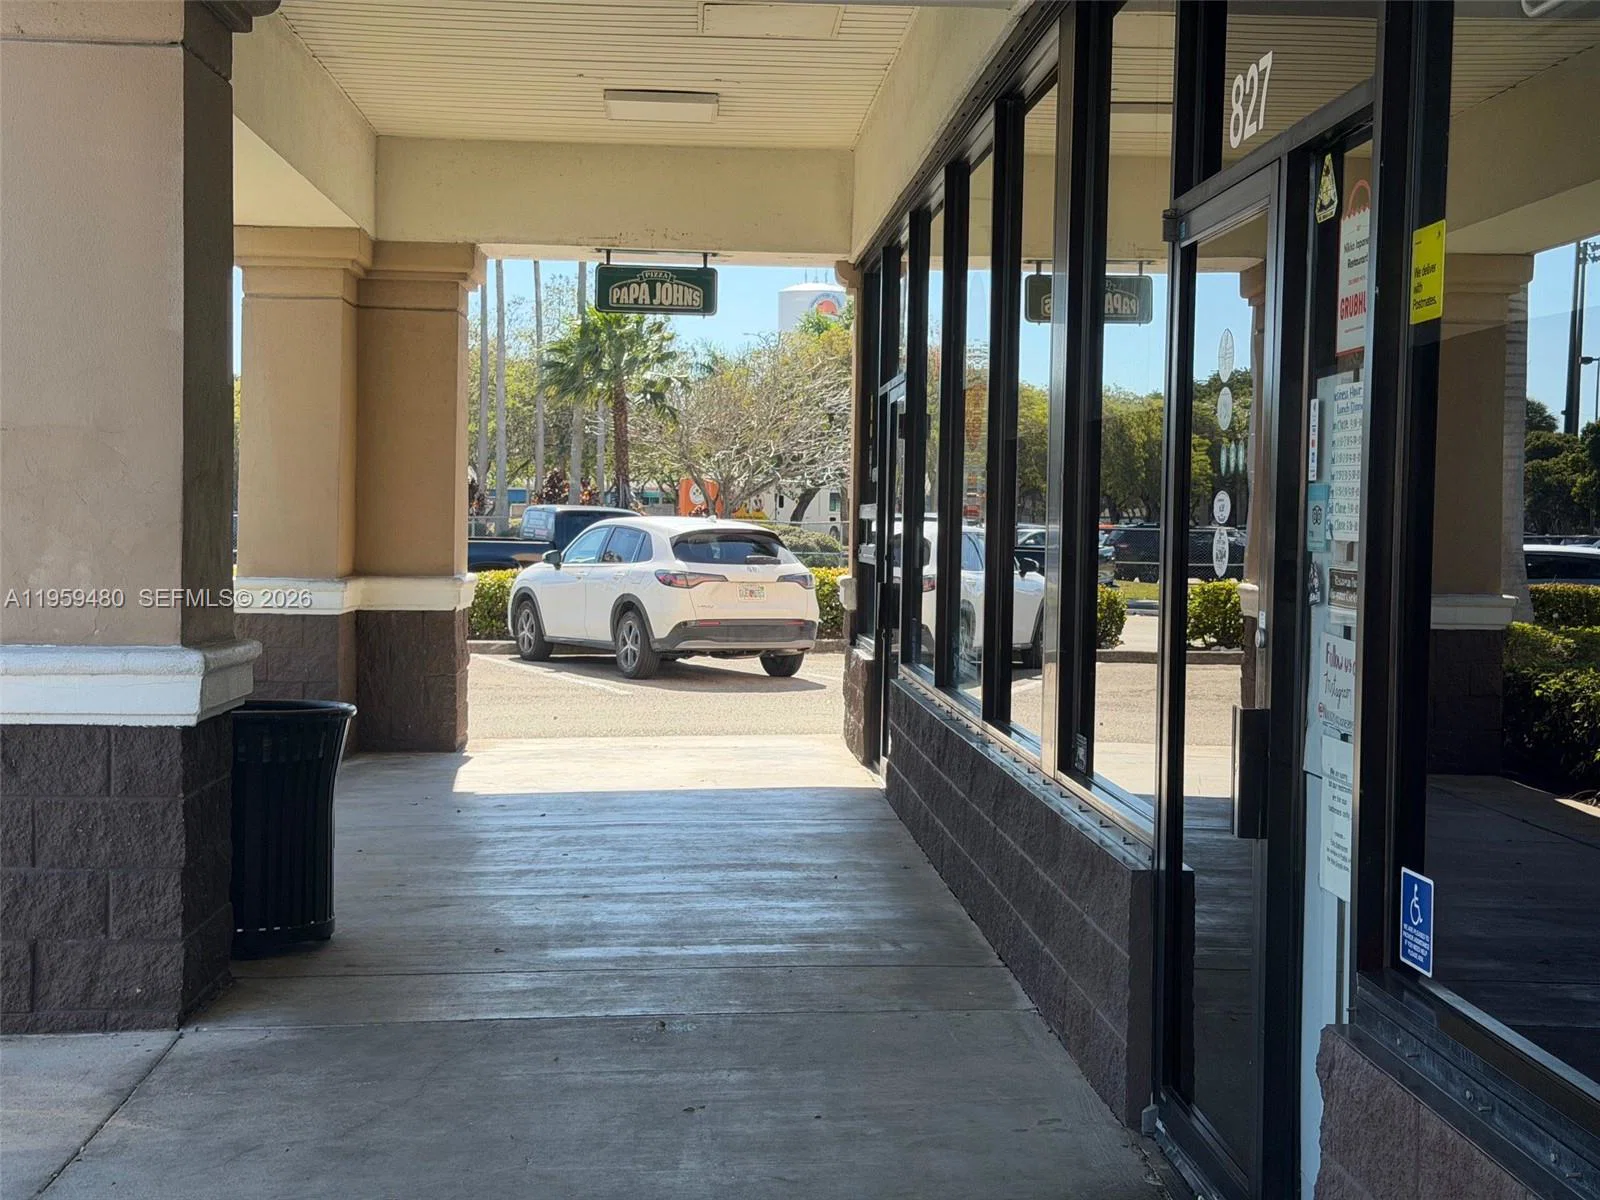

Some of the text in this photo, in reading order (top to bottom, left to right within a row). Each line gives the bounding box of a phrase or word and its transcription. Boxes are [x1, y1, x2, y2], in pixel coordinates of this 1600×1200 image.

[1229, 50, 1273, 149] 827
[645, 271, 669, 279] PIZZA
[612, 282, 700, 306] PAPA JOHNS
